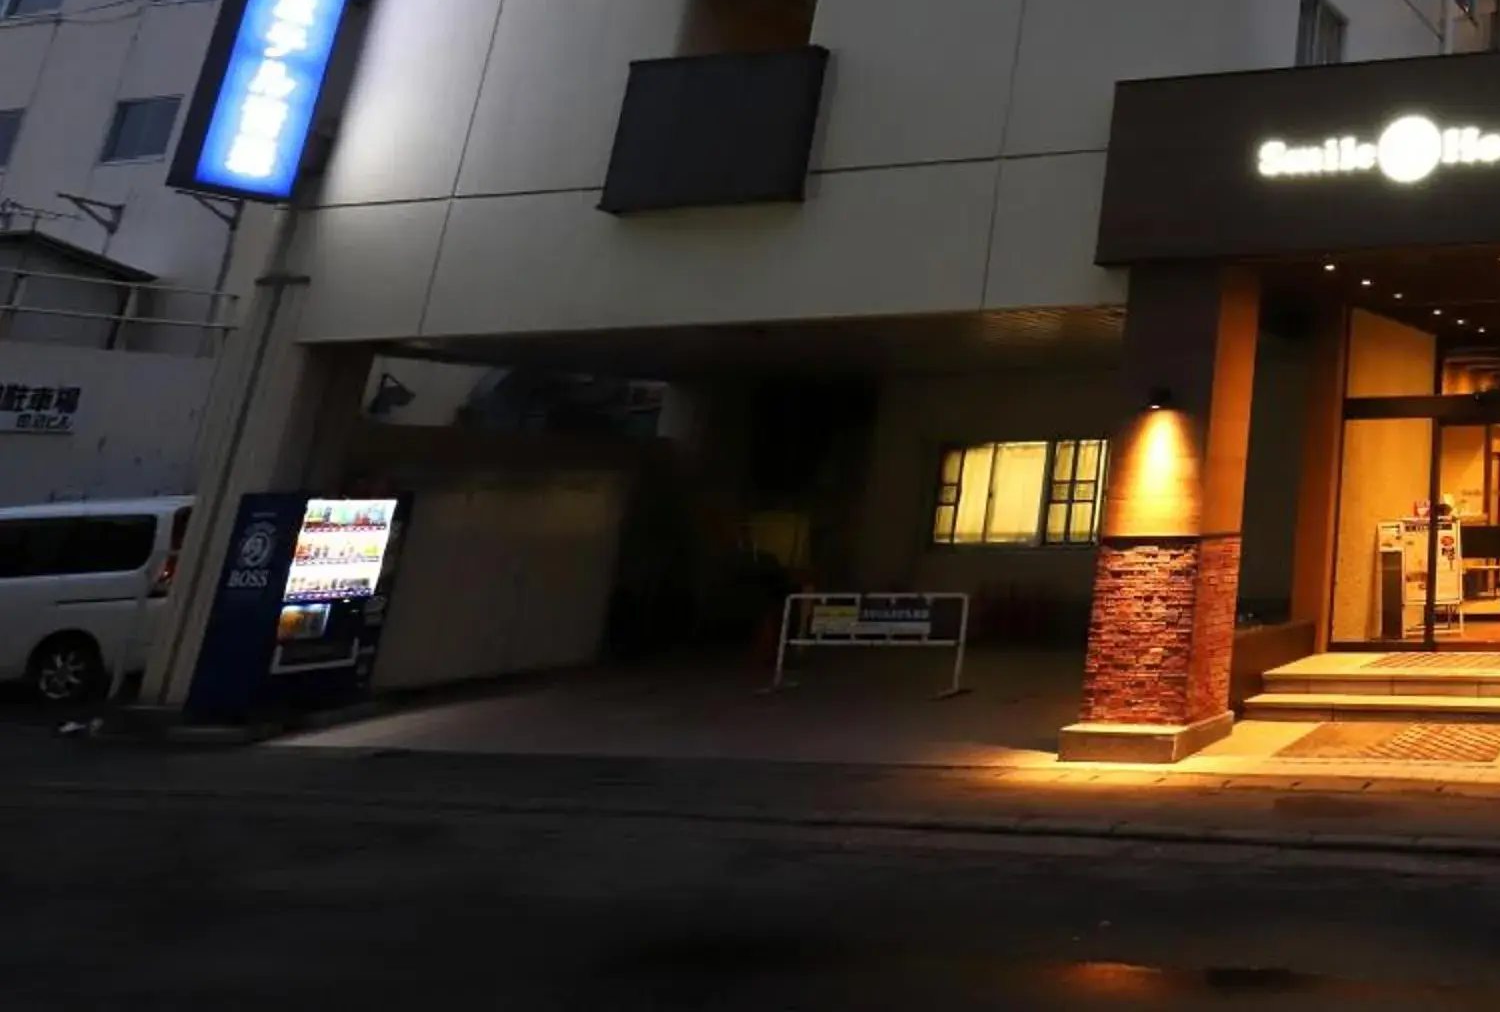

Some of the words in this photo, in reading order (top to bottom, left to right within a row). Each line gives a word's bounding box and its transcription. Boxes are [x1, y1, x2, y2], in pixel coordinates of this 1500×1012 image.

[1257, 135, 1377, 176] Smile
[0, 383, 81, 414] 駐車場
[225, 568, 271, 589] BOSS
